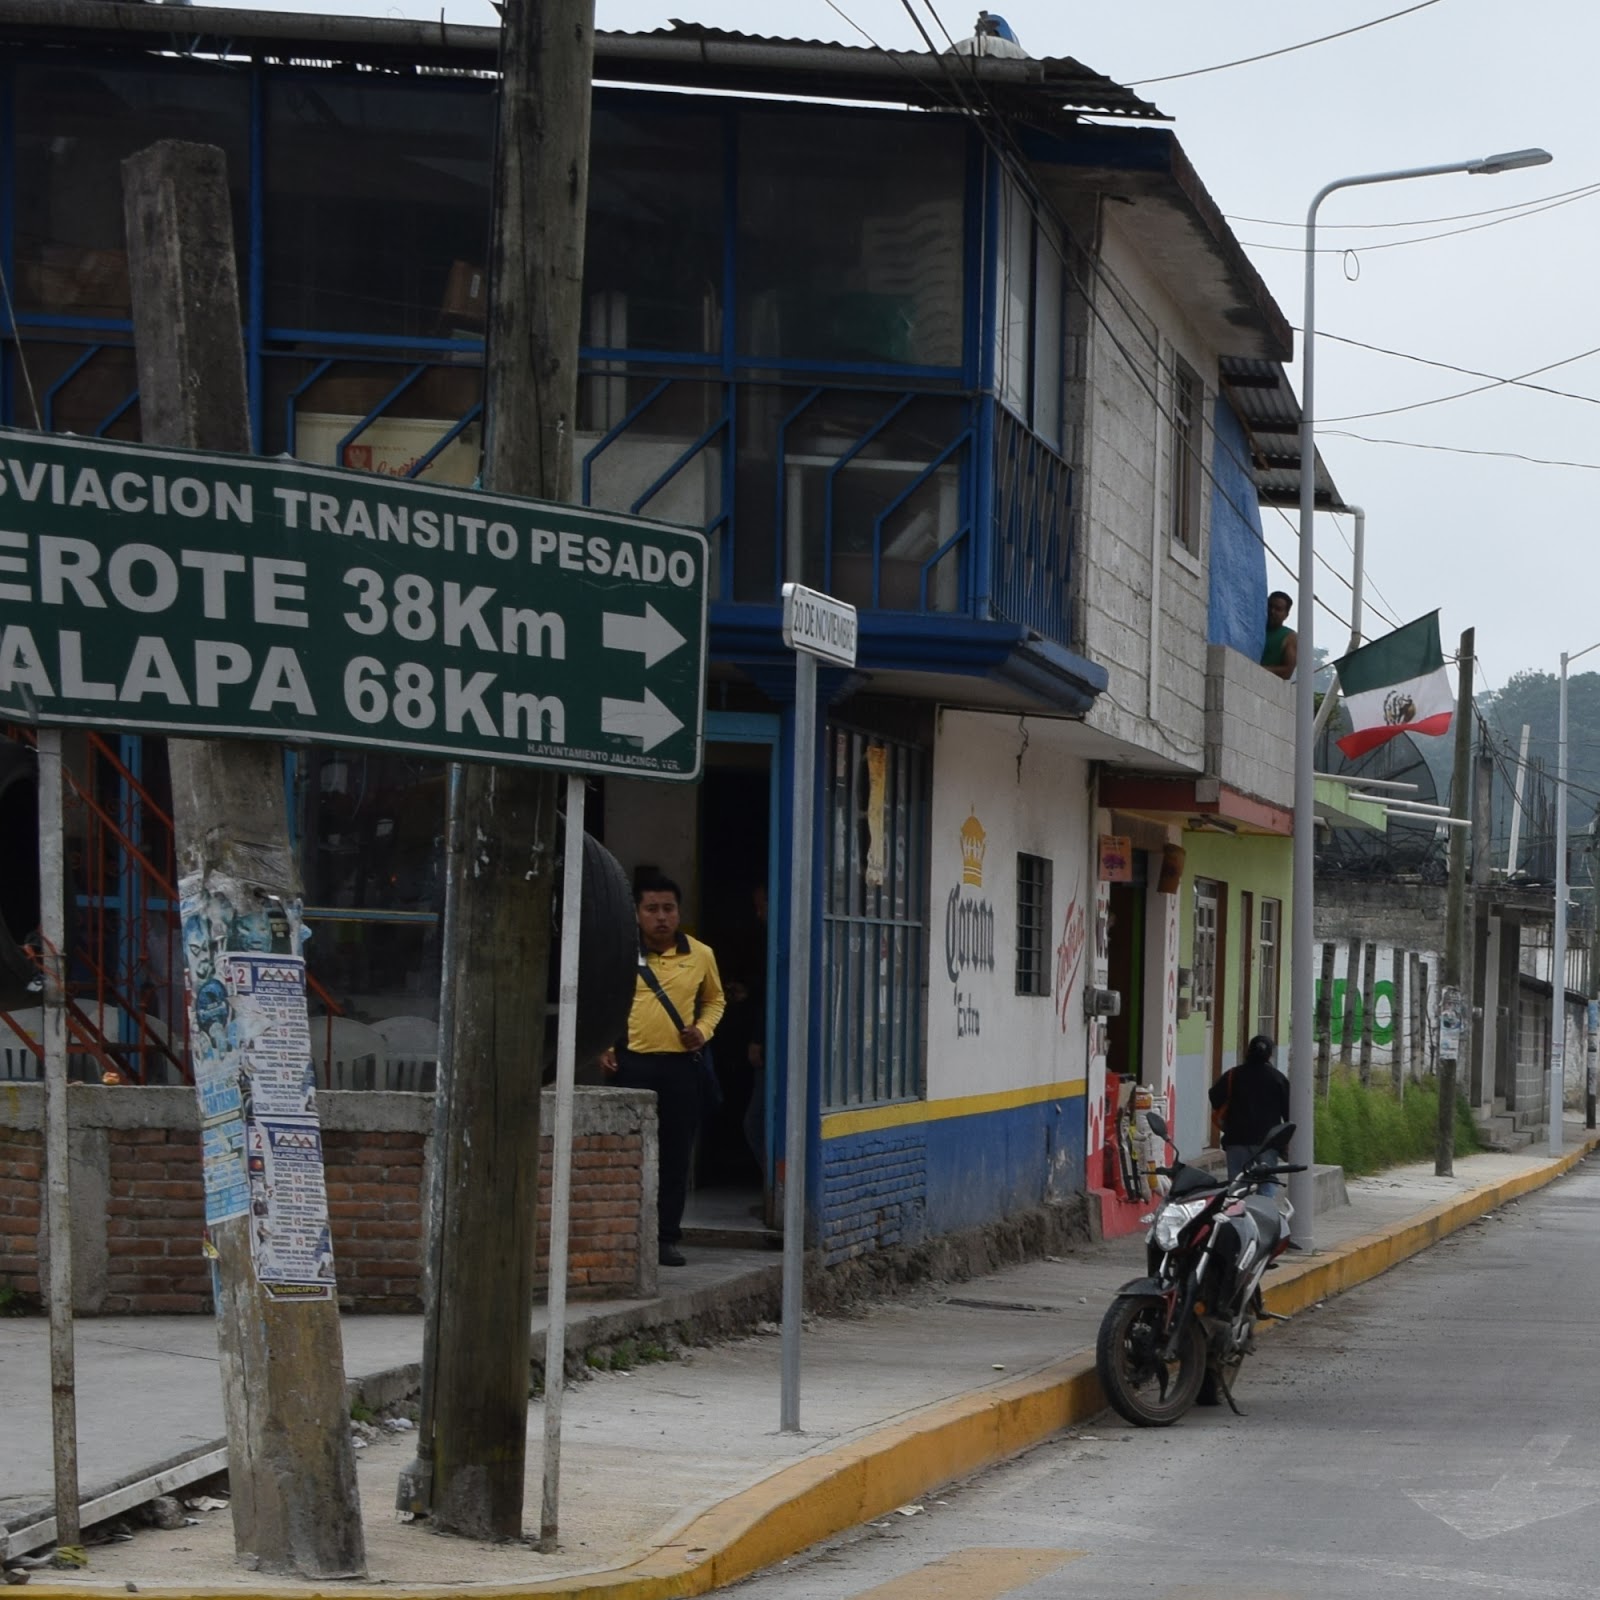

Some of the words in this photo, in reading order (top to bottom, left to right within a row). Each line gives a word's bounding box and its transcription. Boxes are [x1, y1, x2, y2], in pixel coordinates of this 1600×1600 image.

[273, 487, 519, 560] TRANSITO
[530, 527, 695, 588] PESADO
[342, 566, 566, 661] 38Km
[0, 624, 318, 717] ALAPA
[342, 655, 566, 745] 68Km
[945, 880, 995, 984] Corona
